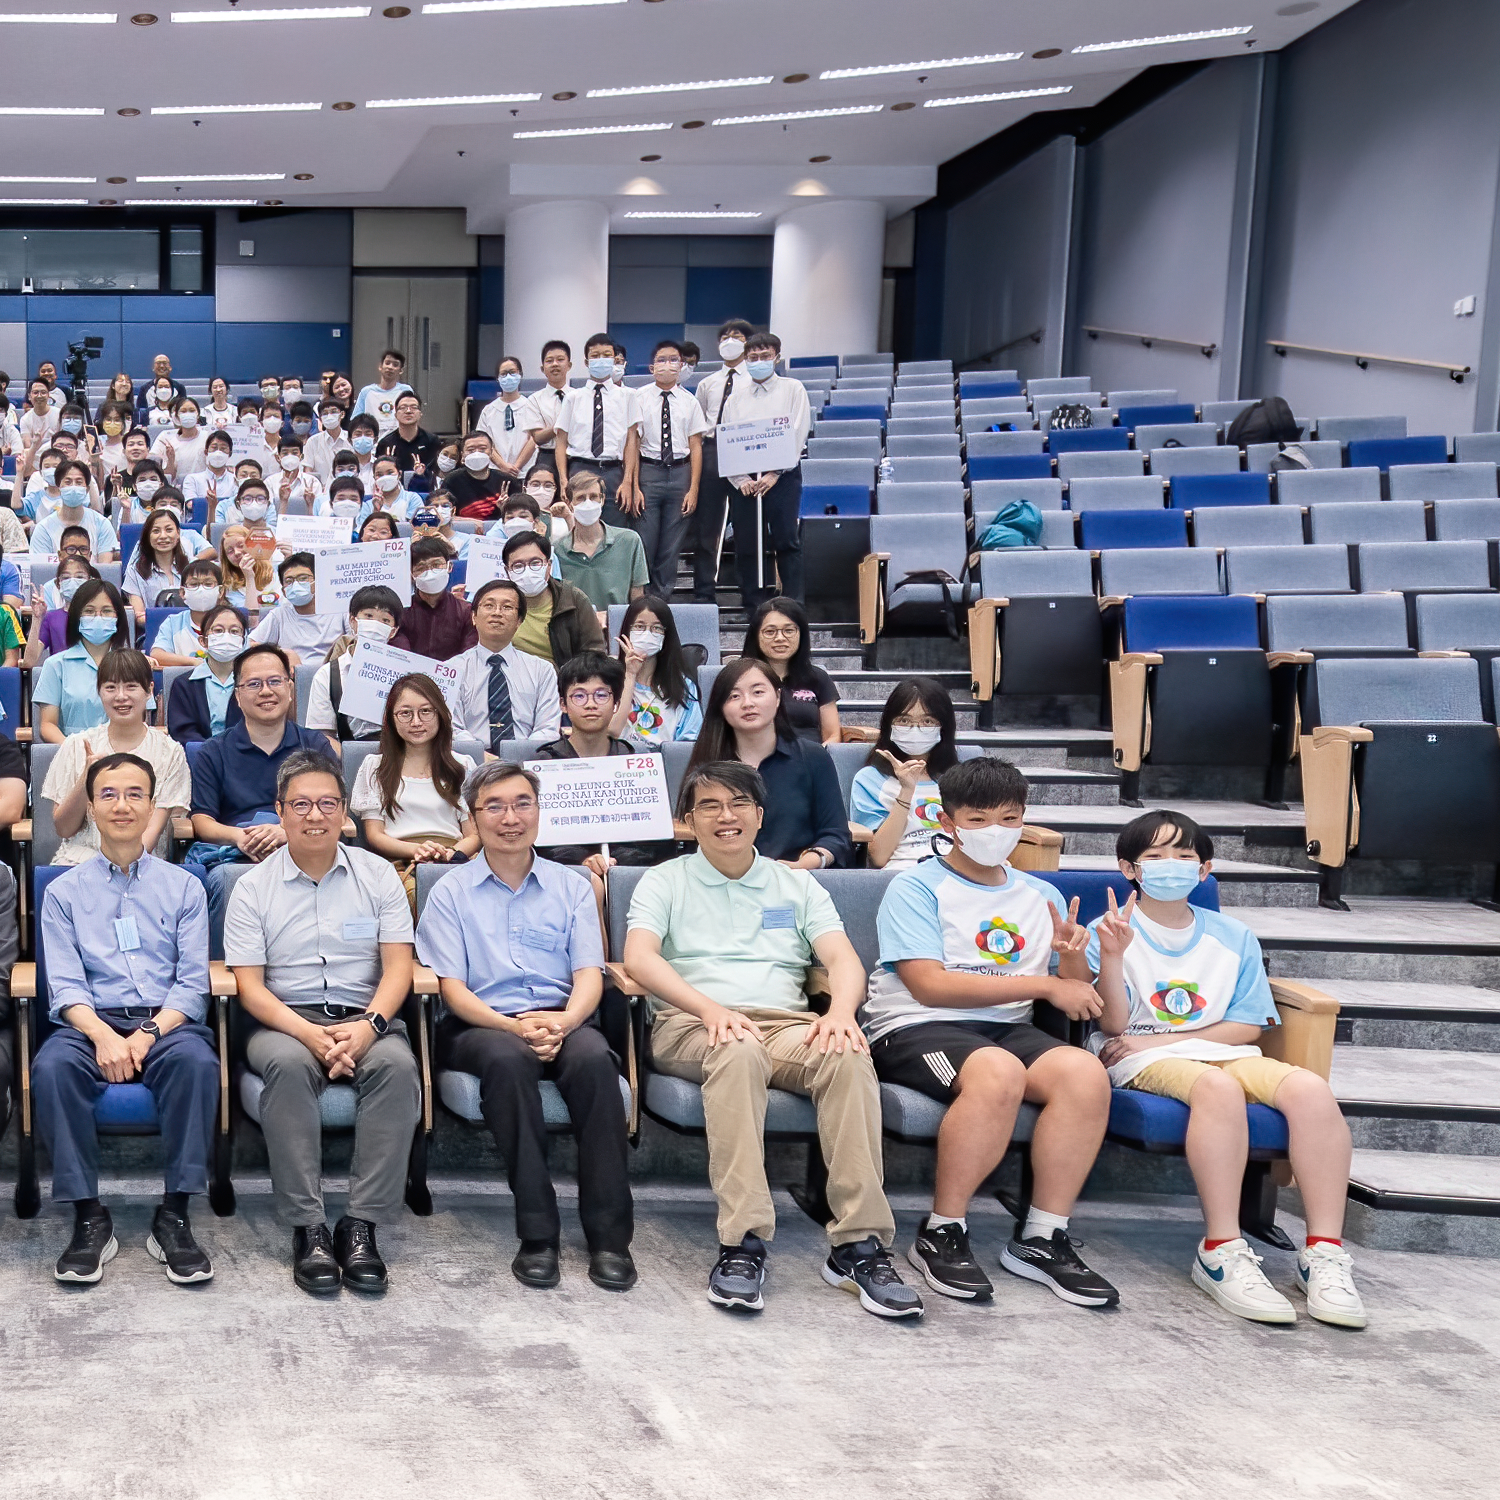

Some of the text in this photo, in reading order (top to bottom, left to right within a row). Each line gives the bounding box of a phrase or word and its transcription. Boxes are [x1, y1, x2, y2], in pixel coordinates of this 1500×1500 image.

[773, 417, 789, 425] F29
[755, 431, 785, 440] COLLEGE
[385, 542, 404, 552] F02
[343, 568, 382, 577] CATHOLIC
[330, 573, 395, 585] PRIMARY SCHOOL
[358, 669, 387, 683] (HONG
[435, 664, 457, 679] F30
[626, 758, 654, 770] F28
[614, 769, 658, 779] Group 10
[557, 780, 635, 792] PO LEUNG KUK
[538, 787, 658, 801] TONG NAI KAN JUNIOR
[538, 795, 659, 810] SECONDARY COLLEGE
